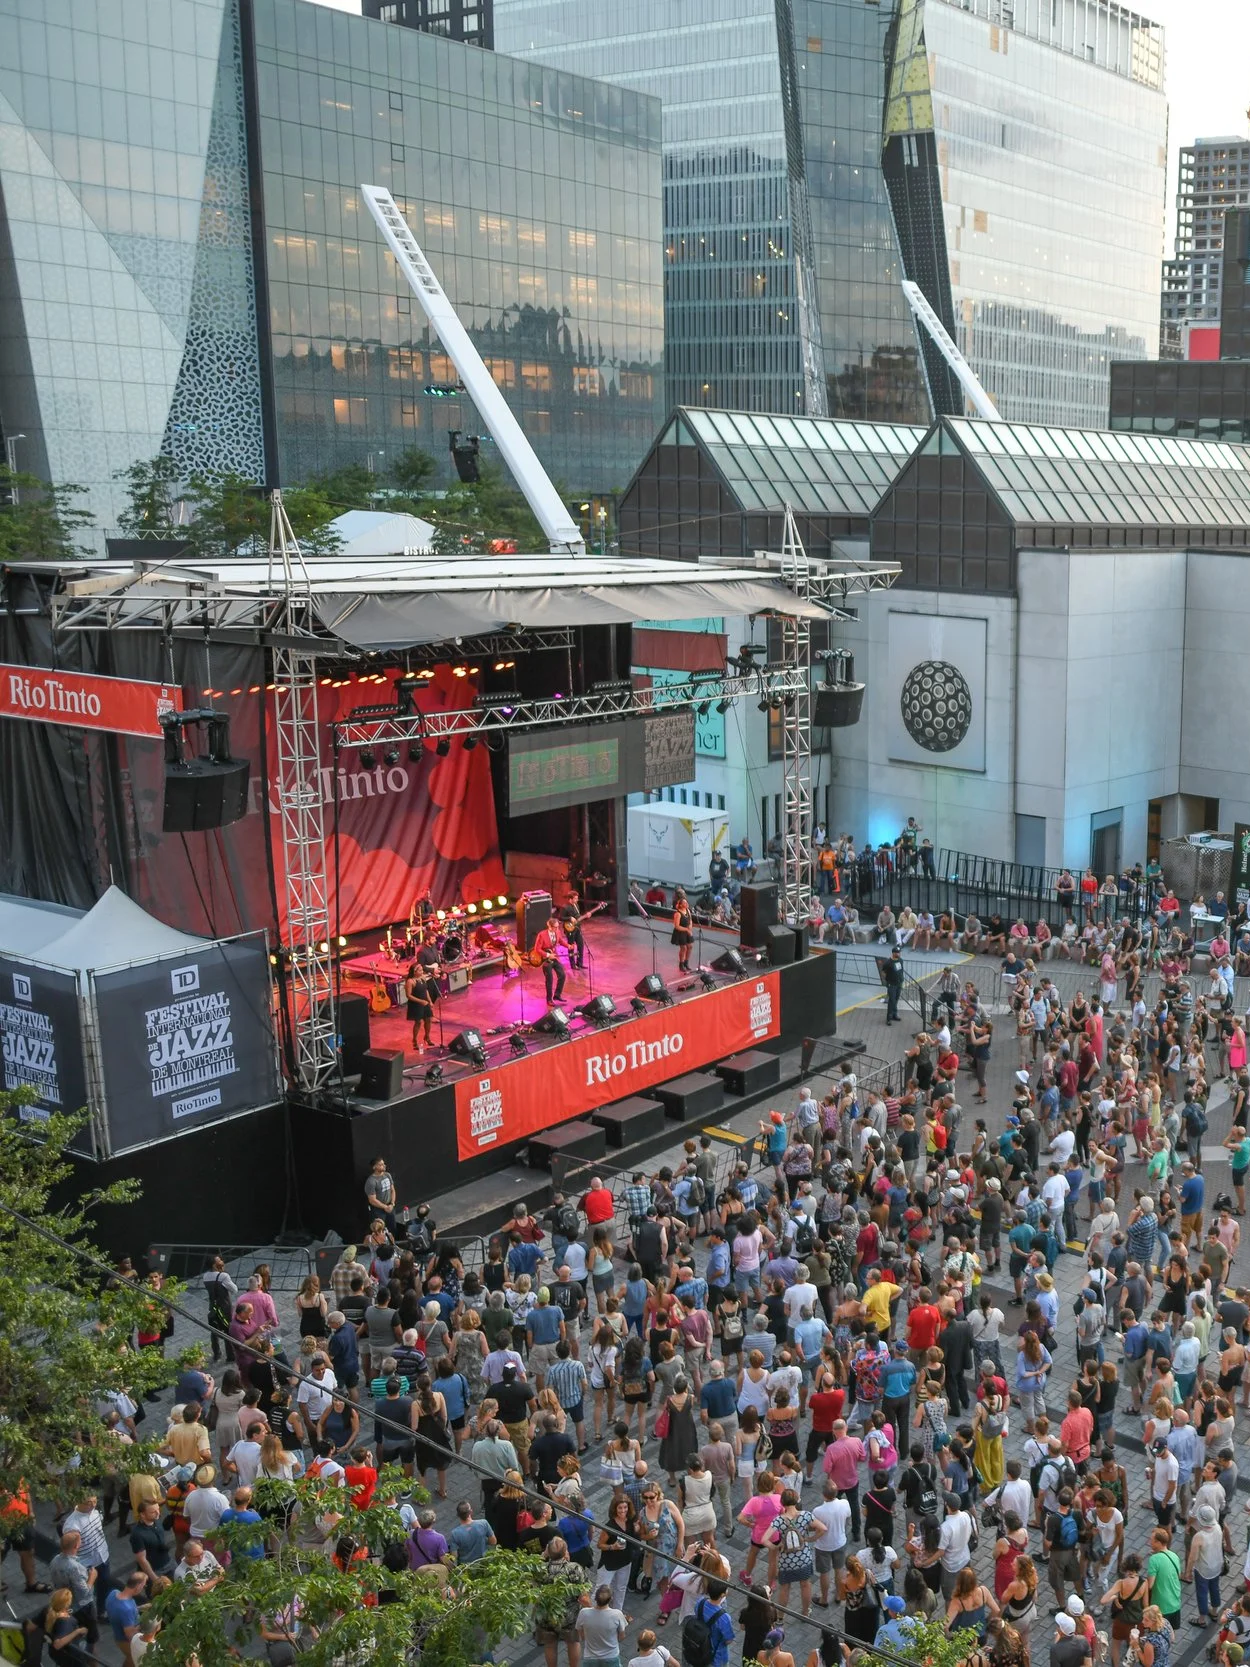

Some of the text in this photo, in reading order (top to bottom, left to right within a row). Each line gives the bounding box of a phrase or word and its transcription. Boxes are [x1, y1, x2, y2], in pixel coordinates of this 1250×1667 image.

[15, 978, 29, 996] TD
[174, 970, 196, 988] TD
[0, 1003, 53, 1034] FESTIVAL
[145, 991, 230, 1028] FESTIVAL
[147, 1006, 231, 1039] INTERNATIONAL
[3, 1031, 57, 1075] JAZZ
[150, 1017, 233, 1067] JAZZ
[151, 1065, 168, 1081] DE
